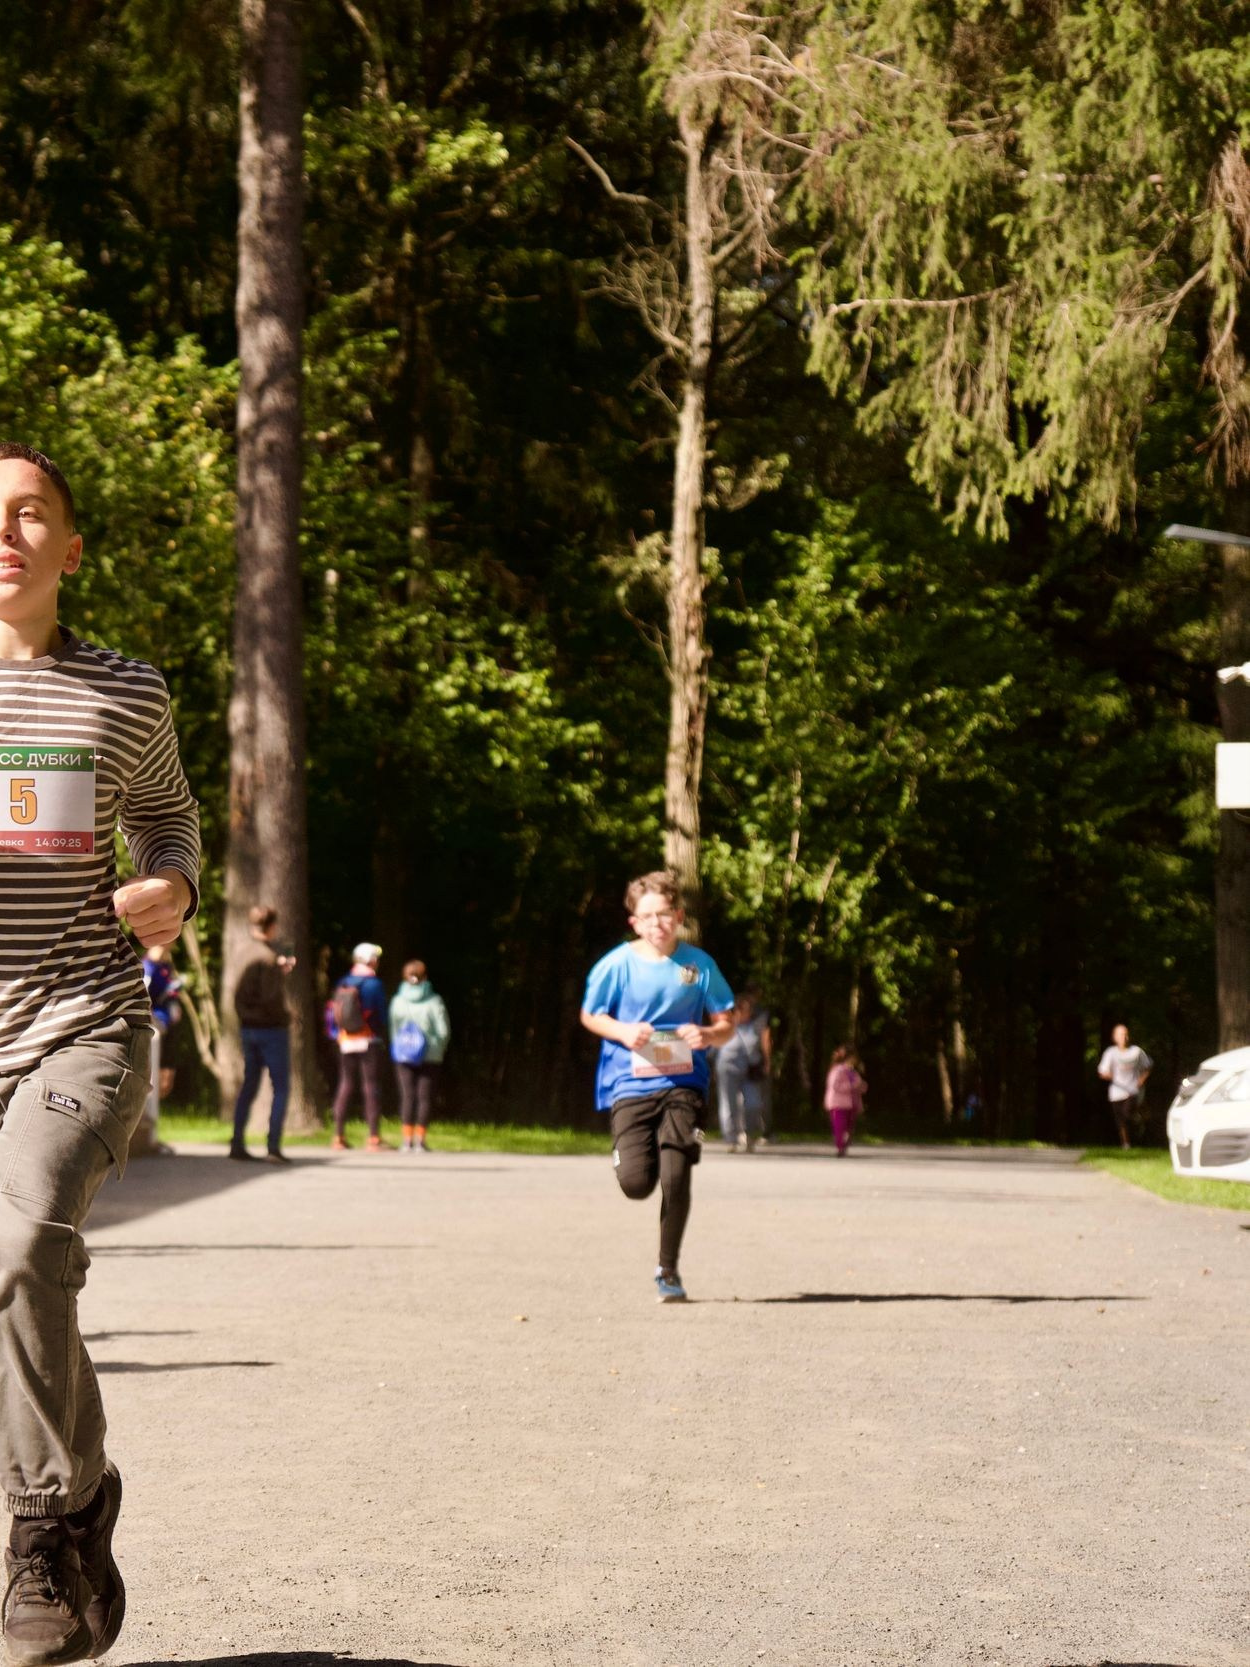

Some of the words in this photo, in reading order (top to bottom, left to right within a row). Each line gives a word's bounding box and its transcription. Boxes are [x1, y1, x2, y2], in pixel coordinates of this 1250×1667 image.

[27, 753, 81, 767] ДУБКИ
[10, 778, 38, 825] 5
[35, 838, 82, 848] 14.09.25
